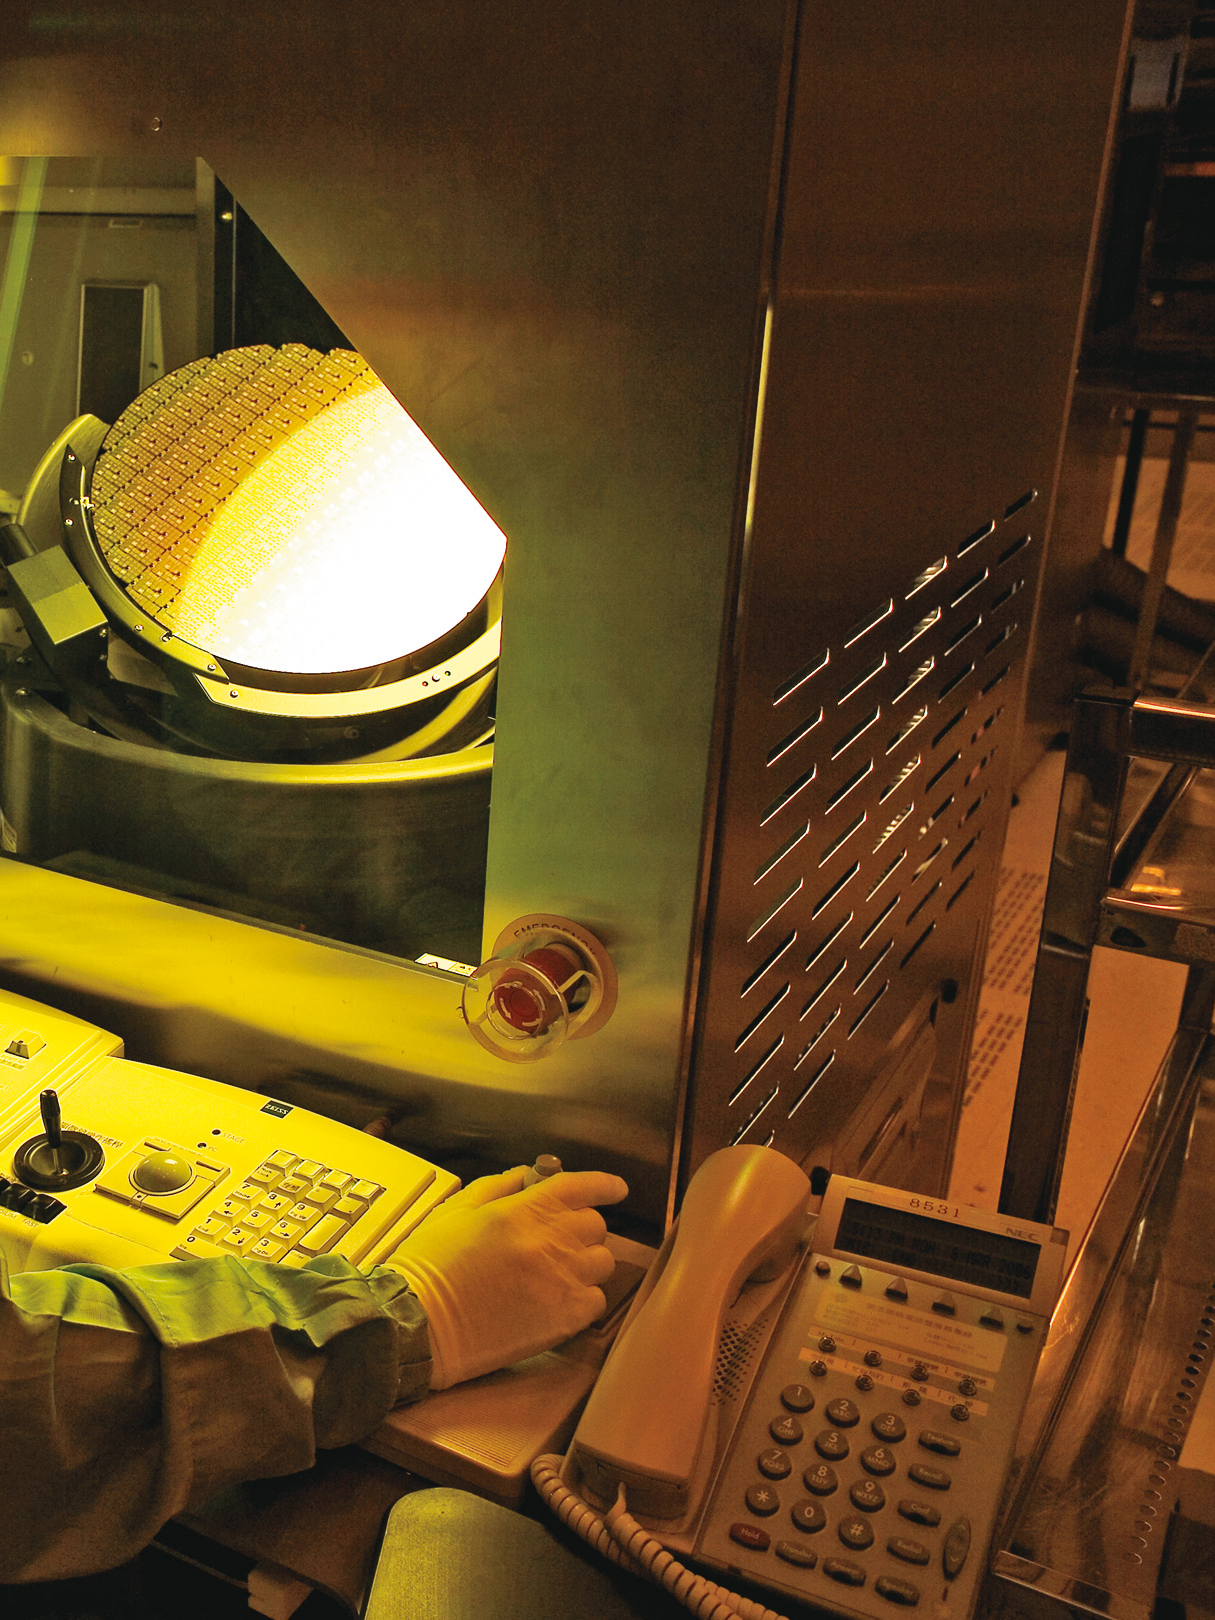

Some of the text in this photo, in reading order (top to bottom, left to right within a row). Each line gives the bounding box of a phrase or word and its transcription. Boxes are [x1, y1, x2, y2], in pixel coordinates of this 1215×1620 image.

[265, 1104, 289, 1114] ZEISS
[222, 1132, 245, 1144] STAGE
[909, 1198, 960, 1218] 8531
[22, 1218, 39, 1228] FAST
[1005, 1227, 1039, 1241] NEC
[797, 1386, 802, 1396] 1
[839, 1400, 849, 1410] 2
[833, 1409, 850, 1418] ABC
[783, 1418, 792, 1428] 4
[885, 1415, 895, 1425] 3
[778, 1426, 794, 1436] GHI
[880, 1424, 896, 1432] DEF
[829, 1432, 839, 1442] 5
[927, 1433, 955, 1446] Feature
[824, 1442, 837, 1451] JKL
[771, 1450, 782, 1460] 7
[875, 1448, 885, 1458] 6
[763, 1459, 784, 1471] PQRS
[867, 1456, 889, 1467] MNO
[817, 1465, 827, 1476] 8
[811, 1475, 829, 1484] TUV
[865, 1481, 875, 1492] 9
[856, 1490, 878, 1502] WXYZ
[804, 1507, 814, 1518] 0
[741, 1528, 760, 1540] Hold
[850, 1524, 864, 1536] #
